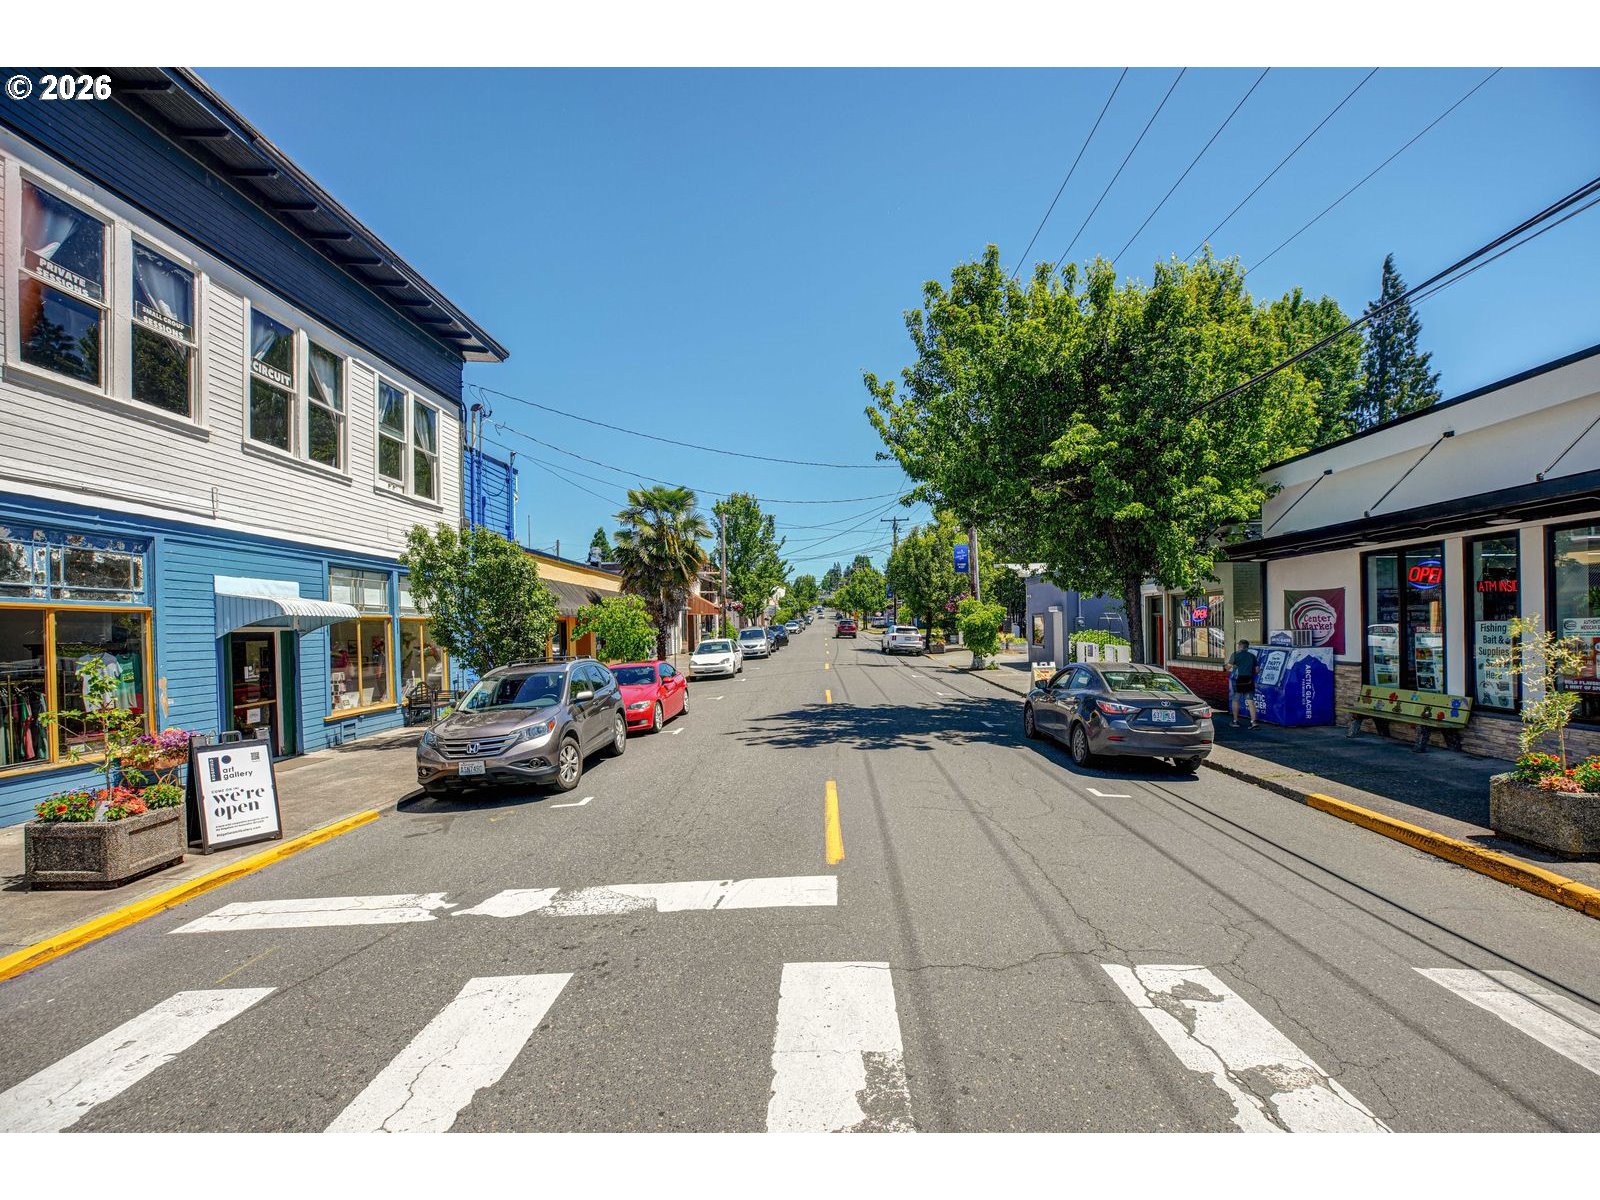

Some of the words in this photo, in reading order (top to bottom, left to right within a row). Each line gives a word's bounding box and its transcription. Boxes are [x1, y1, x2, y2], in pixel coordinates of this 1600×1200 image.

[39, 257, 86, 288] PRIVATE
[36, 266, 89, 297] SESSIONS
[142, 306, 163, 321] SMALL
[163, 316, 185, 330] GROUP
[143, 315, 184, 340] SESSIONS
[252, 360, 291, 386] CIRCUIT
[1478, 580, 1497, 592] ATM
[1304, 614, 1331, 622] Center
[1301, 622, 1332, 630] Market
[1480, 623, 1507, 634] Fishing
[1482, 635, 1497, 644] Bait
[1498, 636, 1504, 644] &
[1478, 646, 1510, 656] Supplies
[222, 766, 235, 774] art
[223, 770, 253, 781] gallery
[212, 787, 265, 804] we're
[214, 800, 260, 820] open
